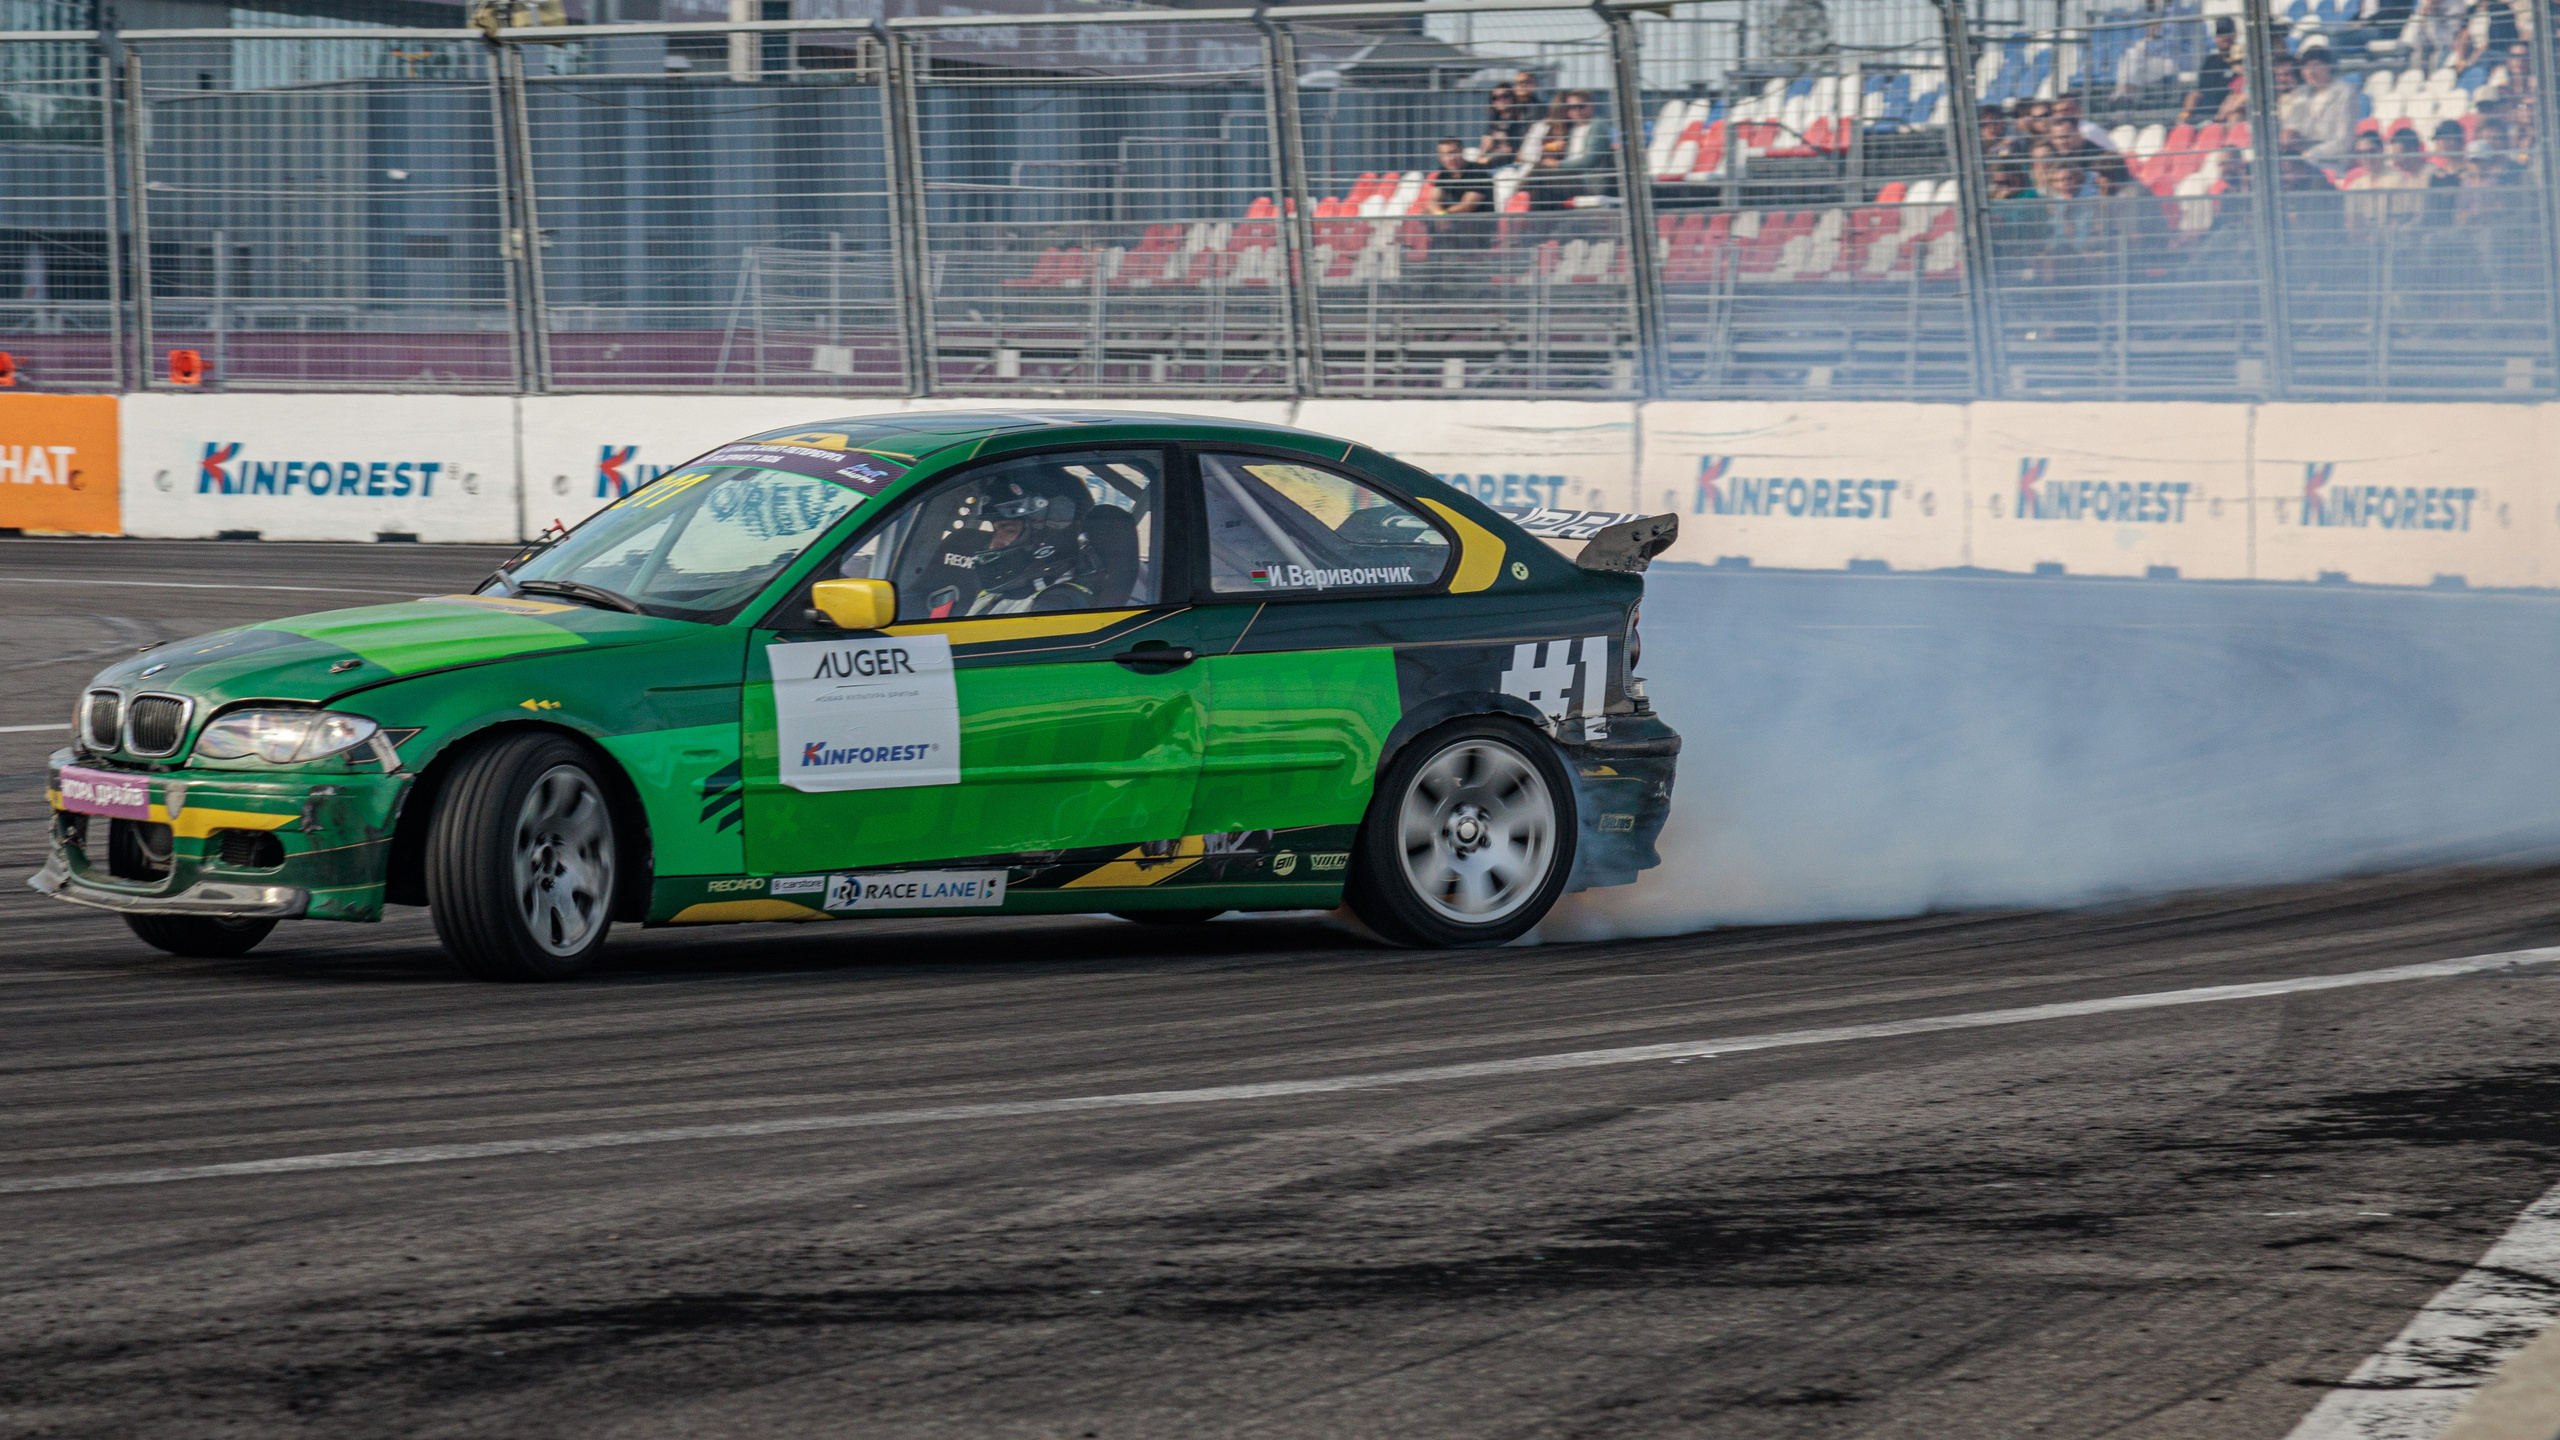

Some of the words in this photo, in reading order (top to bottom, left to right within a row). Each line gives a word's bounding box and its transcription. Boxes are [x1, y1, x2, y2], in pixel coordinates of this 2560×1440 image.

[196, 441, 444, 497] KINFOREST
[1693, 454, 1898, 519] KINFOREST
[2016, 457, 2191, 523] KINFOREST
[2301, 462, 2477, 532] KINFOREST
[812, 647, 916, 680] AUGER
[1499, 635, 1609, 741] #1
[801, 741, 930, 767] KINFOREST
[707, 877, 766, 893] RECARO
[864, 883, 918, 900] RACE
[921, 881, 977, 899] LANE
